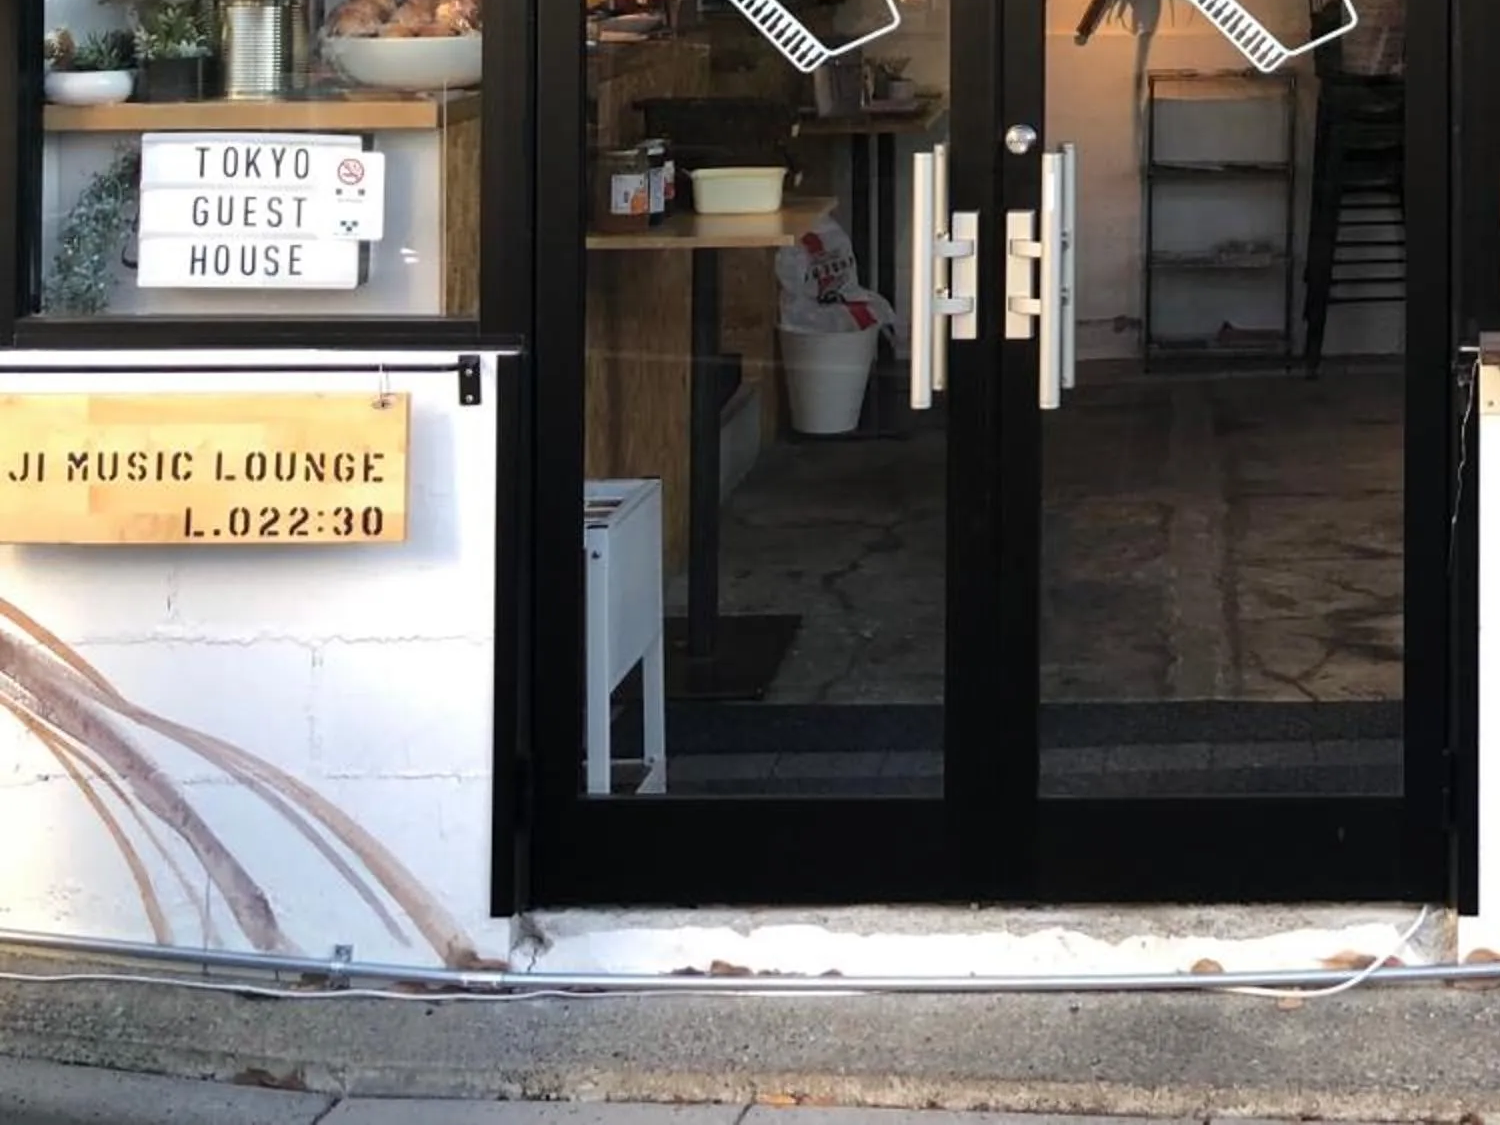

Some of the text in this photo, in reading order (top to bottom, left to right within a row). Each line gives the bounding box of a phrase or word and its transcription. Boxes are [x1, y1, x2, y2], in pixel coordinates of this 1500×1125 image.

[195, 146, 311, 181] TOKYO
[192, 196, 308, 229] GUEST
[189, 244, 303, 276] HOUSE
[8, 451, 385, 482] JI MUSIC LOUNGE
